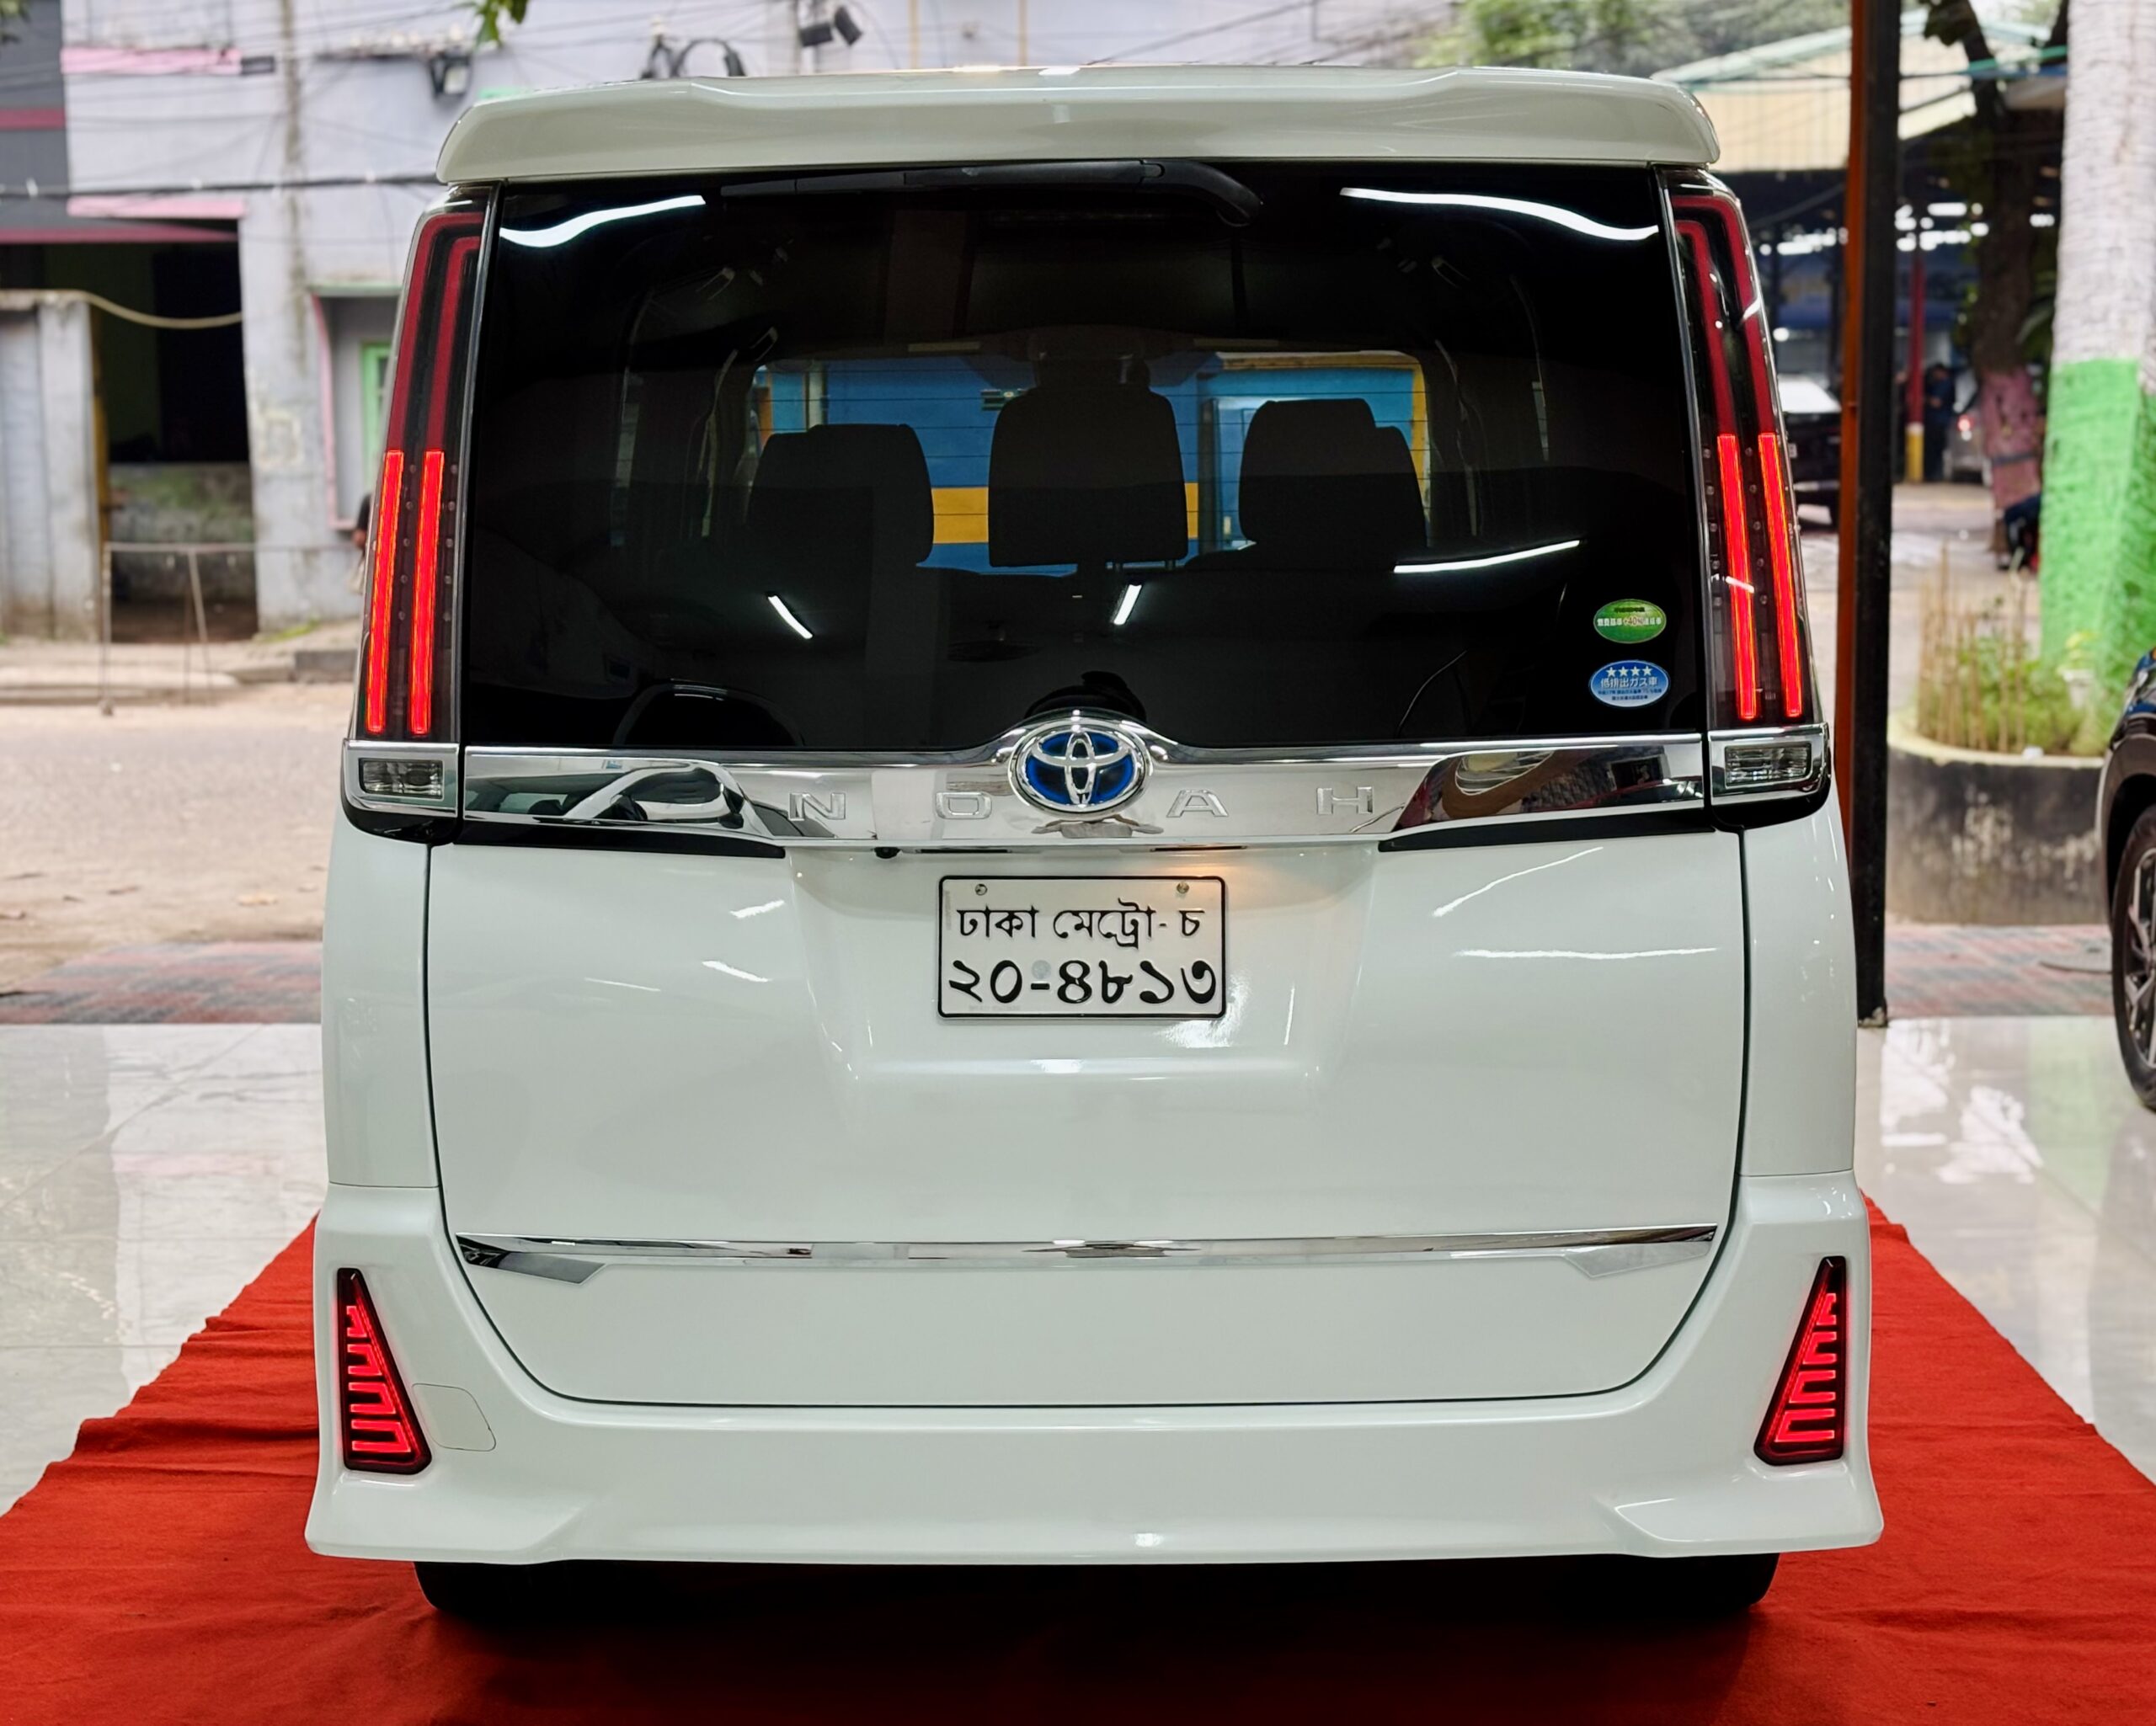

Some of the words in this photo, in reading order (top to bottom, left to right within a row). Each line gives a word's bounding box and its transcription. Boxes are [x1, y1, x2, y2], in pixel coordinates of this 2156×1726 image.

[1601, 677, 1657, 688] 低排出ガス車
[956, 904, 1039, 938] ঢাকা
[948, 959, 1217, 1004] ২০-৪৮১৩
